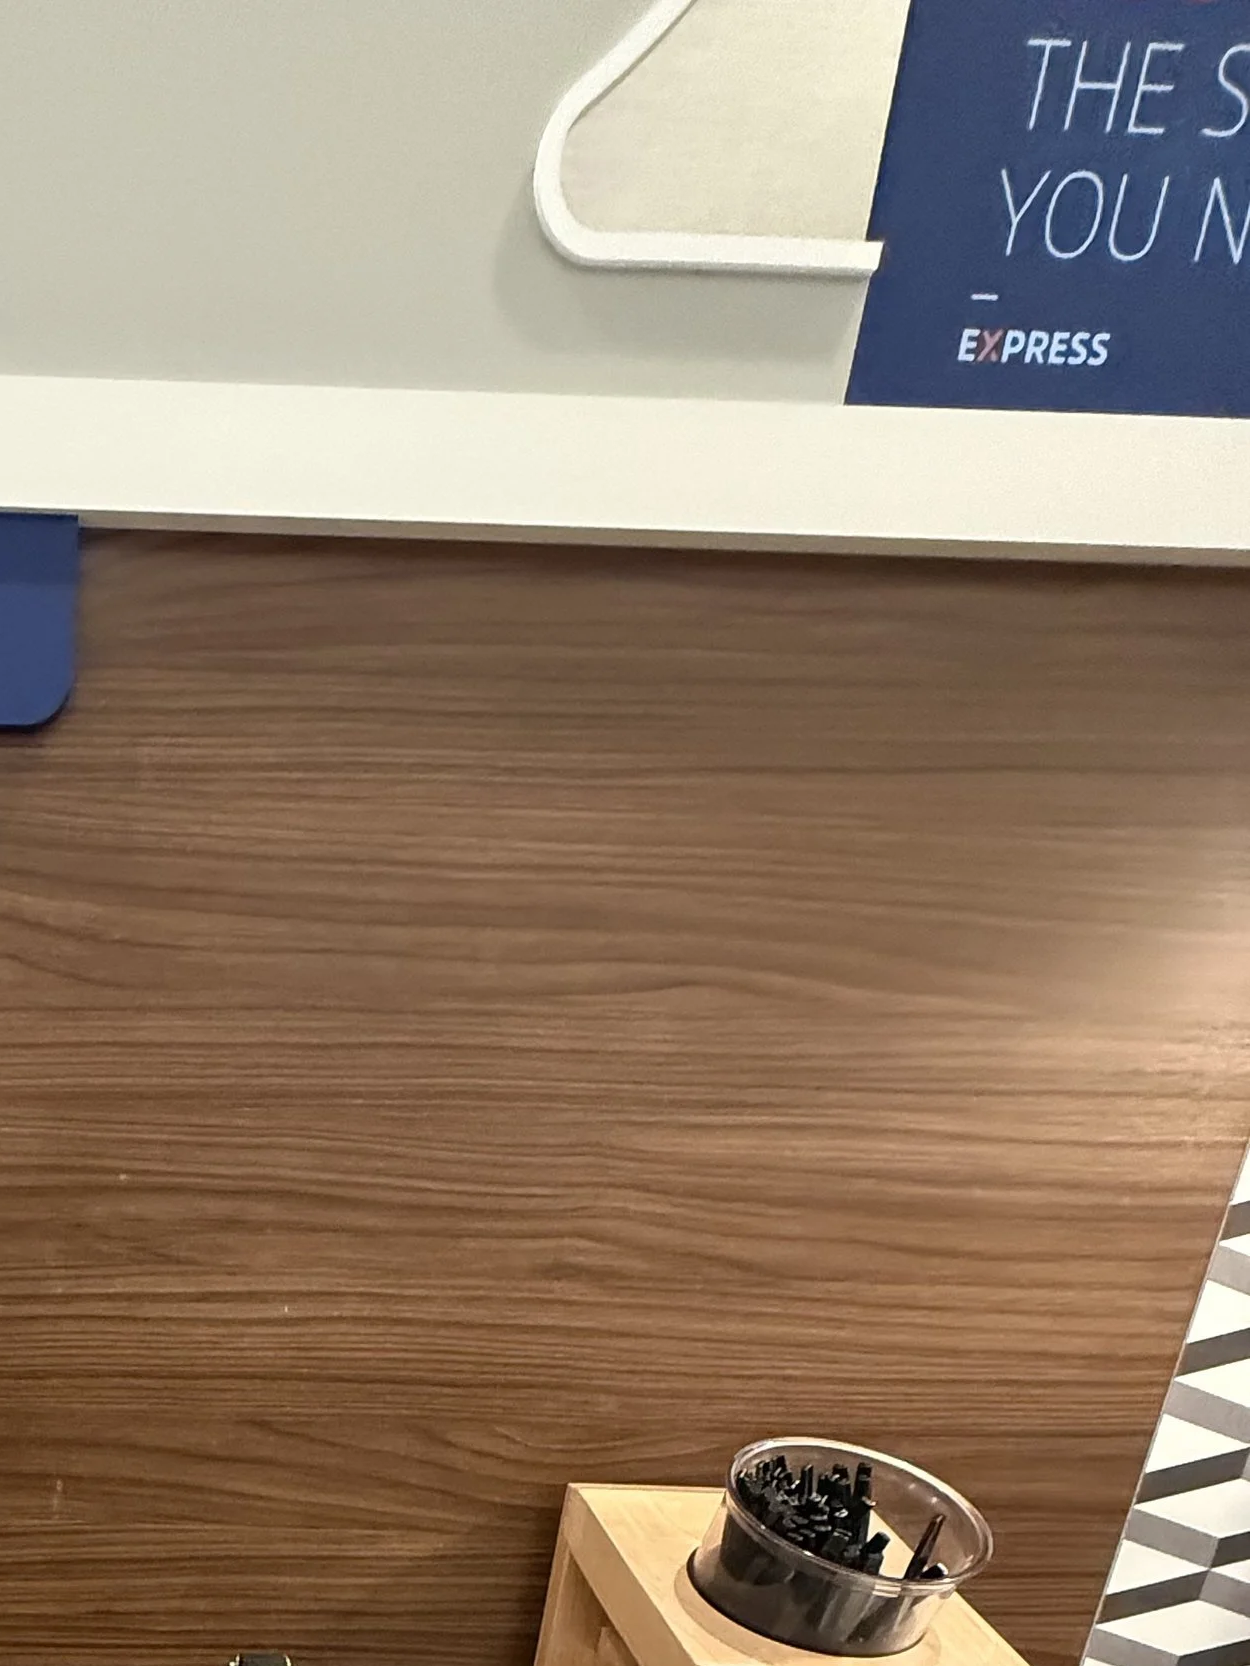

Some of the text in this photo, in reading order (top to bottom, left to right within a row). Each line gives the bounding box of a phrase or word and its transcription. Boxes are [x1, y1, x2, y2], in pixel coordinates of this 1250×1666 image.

[1026, 38, 1186, 135] THE
[1000, 168, 1170, 263] YOU
[956, 327, 1112, 366] EXPRESS
